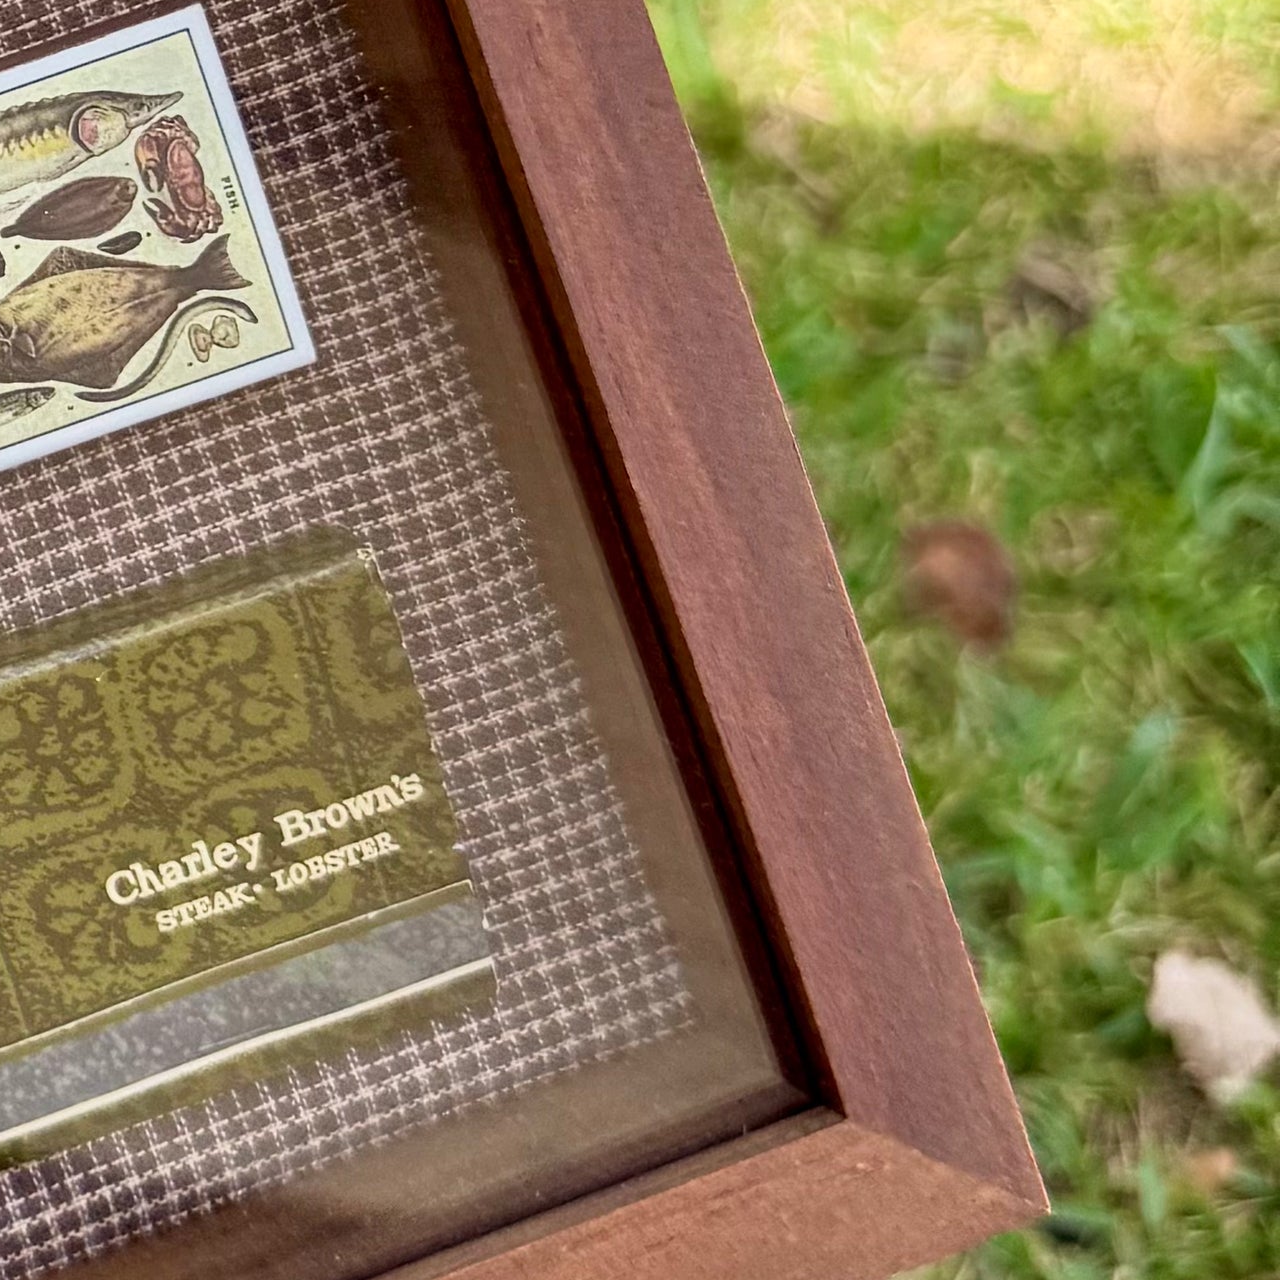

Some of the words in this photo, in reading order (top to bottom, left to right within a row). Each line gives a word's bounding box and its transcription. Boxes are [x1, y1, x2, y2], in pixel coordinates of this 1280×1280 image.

[105, 831, 263, 905] Charley
[273, 772, 424, 847] Brown's
[155, 882, 255, 933] STEAK
[271, 831, 401, 892] LOBSTER
